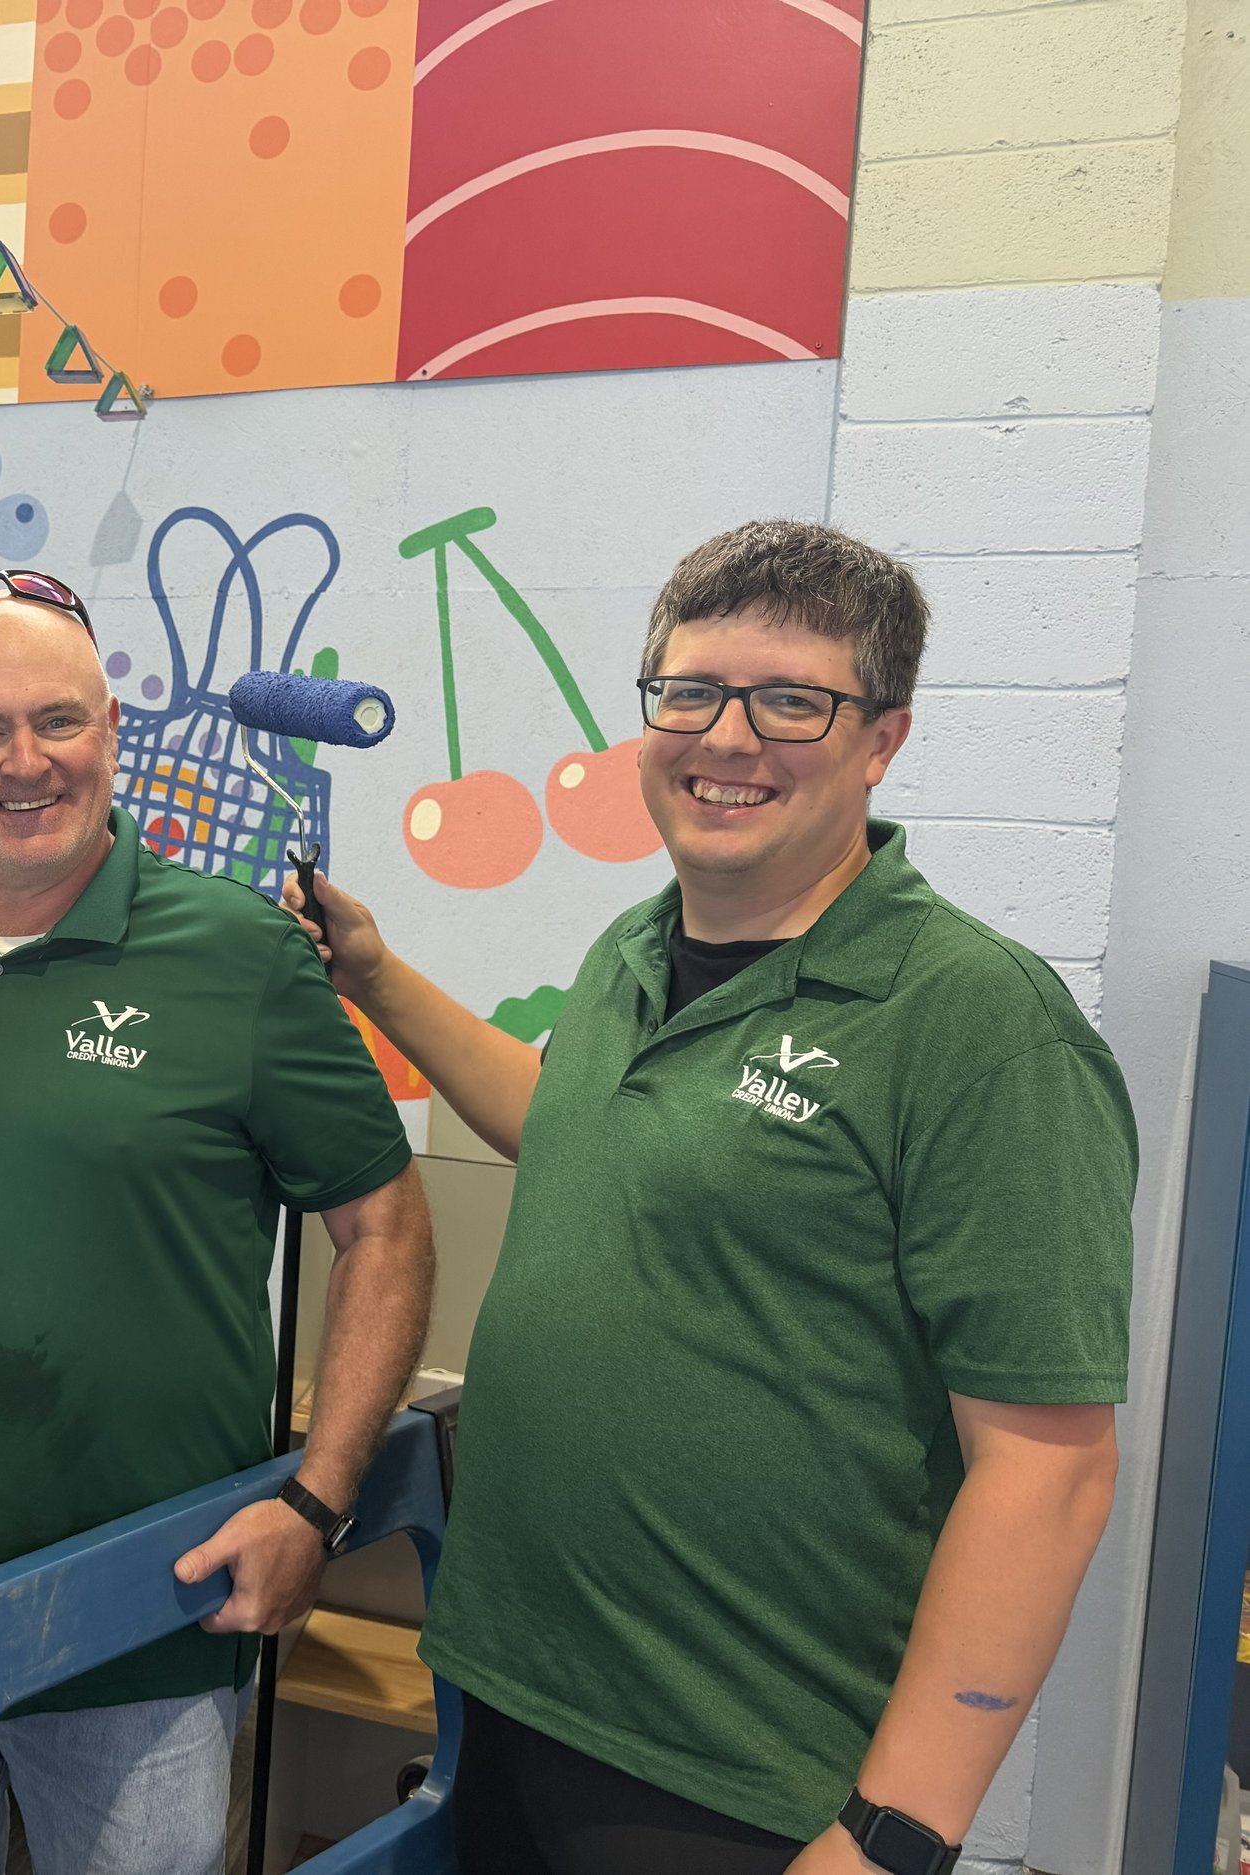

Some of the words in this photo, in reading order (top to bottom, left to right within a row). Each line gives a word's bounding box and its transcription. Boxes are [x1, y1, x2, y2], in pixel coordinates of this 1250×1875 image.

[65, 1029, 148, 1068] Valley
[66, 1050, 97, 1062] CREDIT
[101, 1055, 129, 1069] UNION
[731, 1088, 764, 1107] CREDIT
[764, 1102, 794, 1121] UNION
[738, 1065, 821, 1122] Valley
